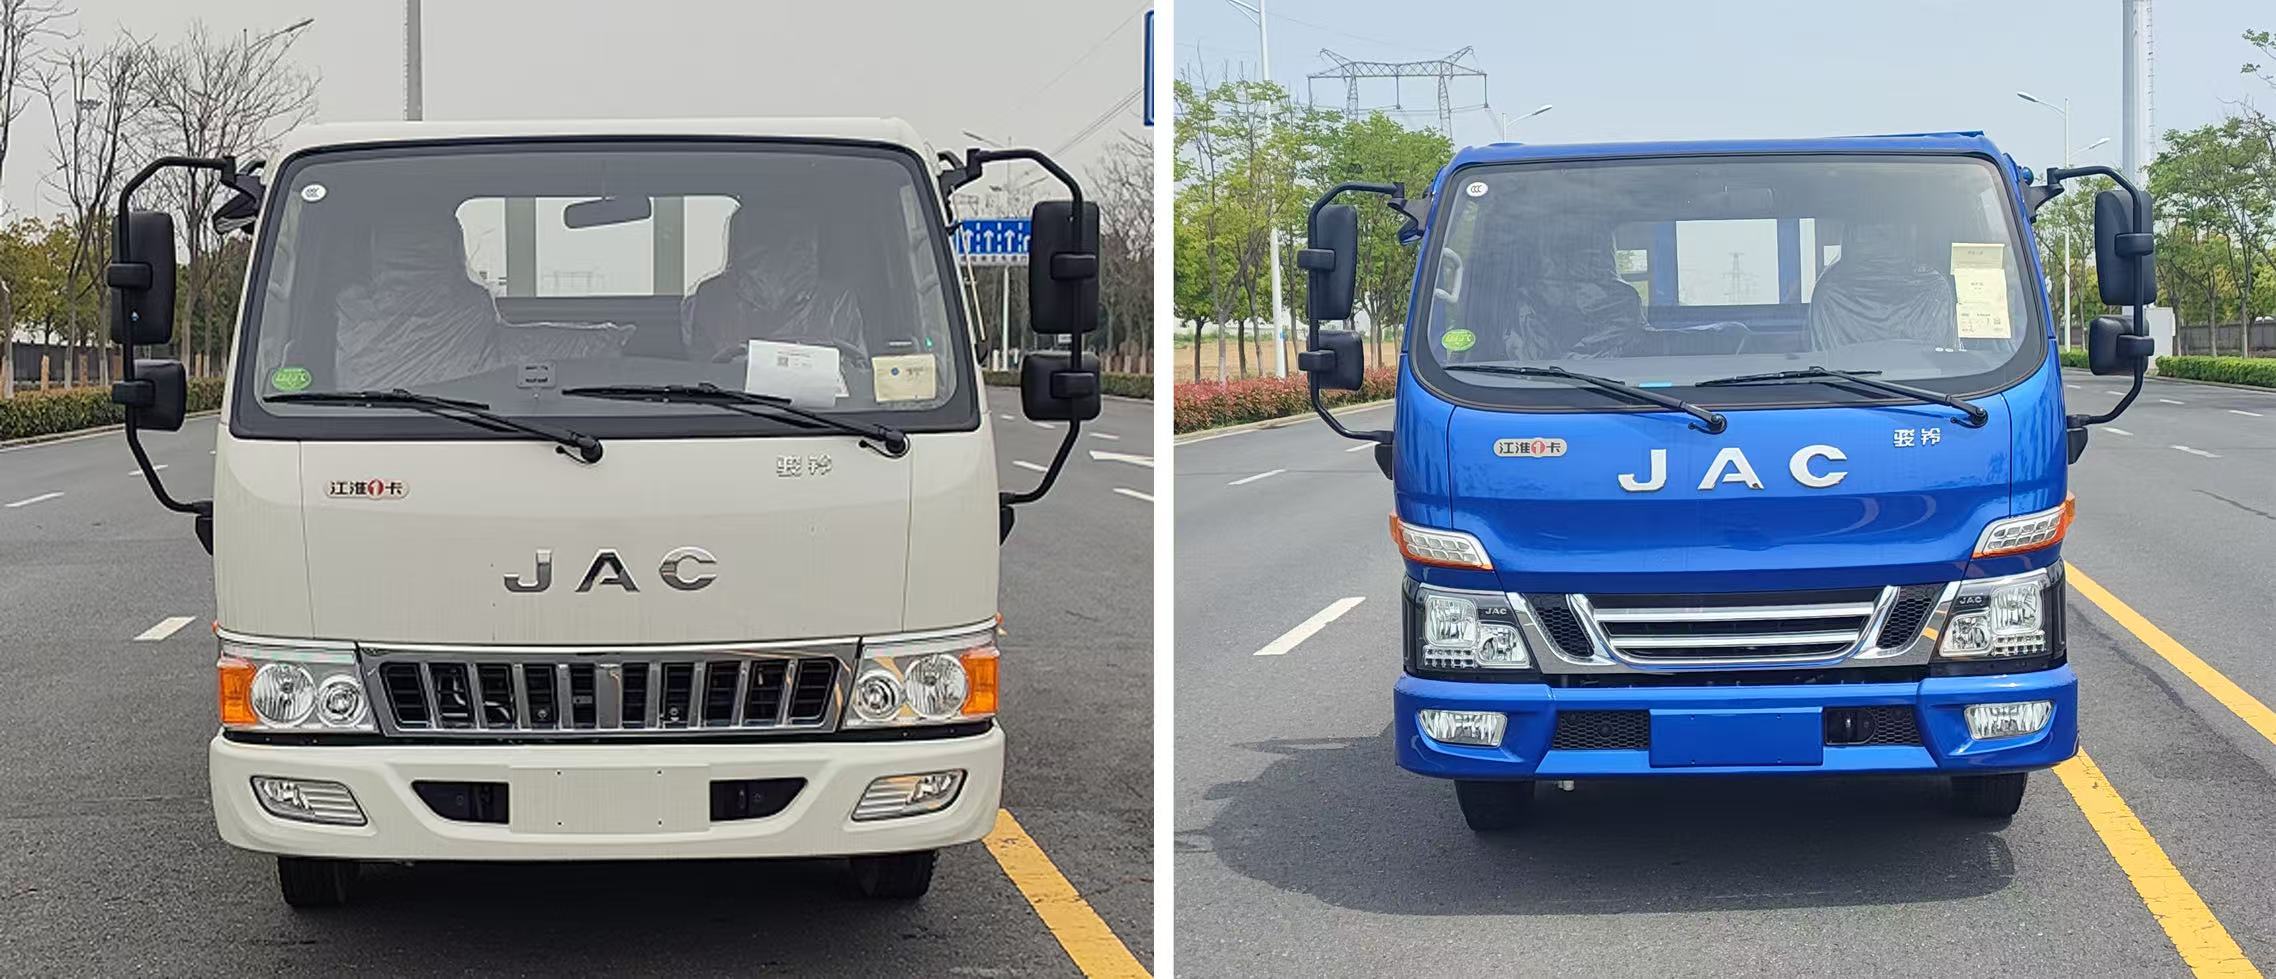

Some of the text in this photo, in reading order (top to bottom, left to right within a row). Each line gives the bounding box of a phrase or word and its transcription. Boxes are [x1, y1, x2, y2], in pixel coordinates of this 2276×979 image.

[1893, 427, 1941, 447] 骏铃
[1617, 444, 1848, 492] JAC
[503, 546, 717, 592] JAC
[1960, 596, 1982, 604] JAC
[1484, 607, 1507, 615] JAC
